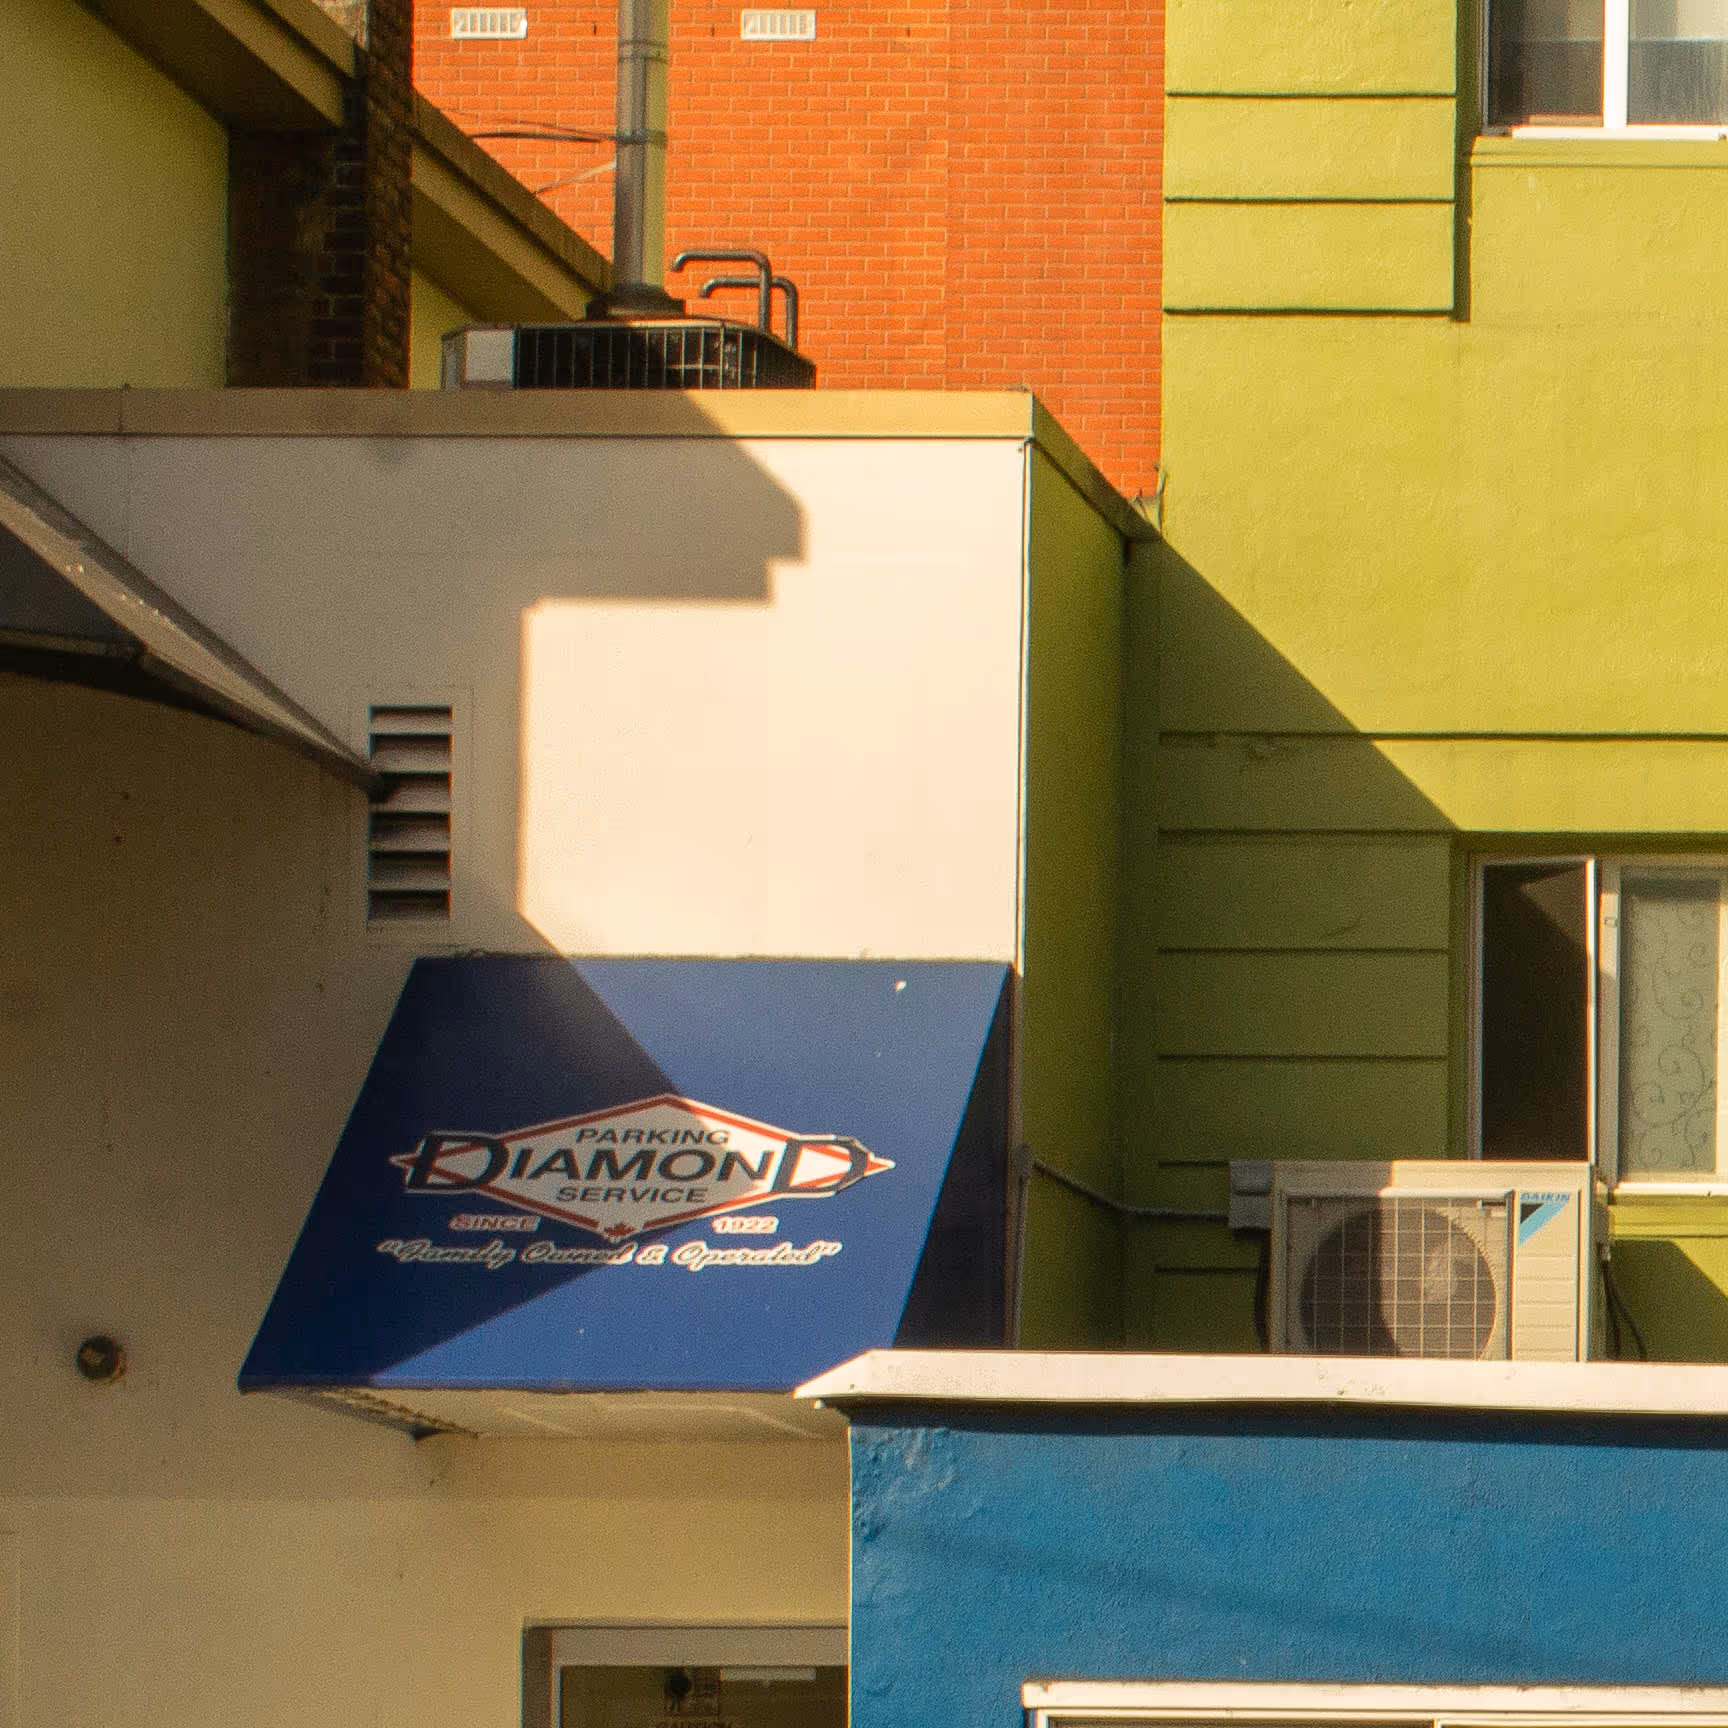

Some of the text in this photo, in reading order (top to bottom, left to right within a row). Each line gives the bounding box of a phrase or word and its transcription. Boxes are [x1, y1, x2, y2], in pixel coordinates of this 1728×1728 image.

[576, 1128, 731, 1145] PARKING
[403, 1133, 870, 1195] DIAMOND
[556, 1186, 708, 1202] SERVICE
[449, 1213, 779, 1234] SINCE 1922
[519, 1241, 638, 1264] Owned
[635, 1244, 669, 1265] &
